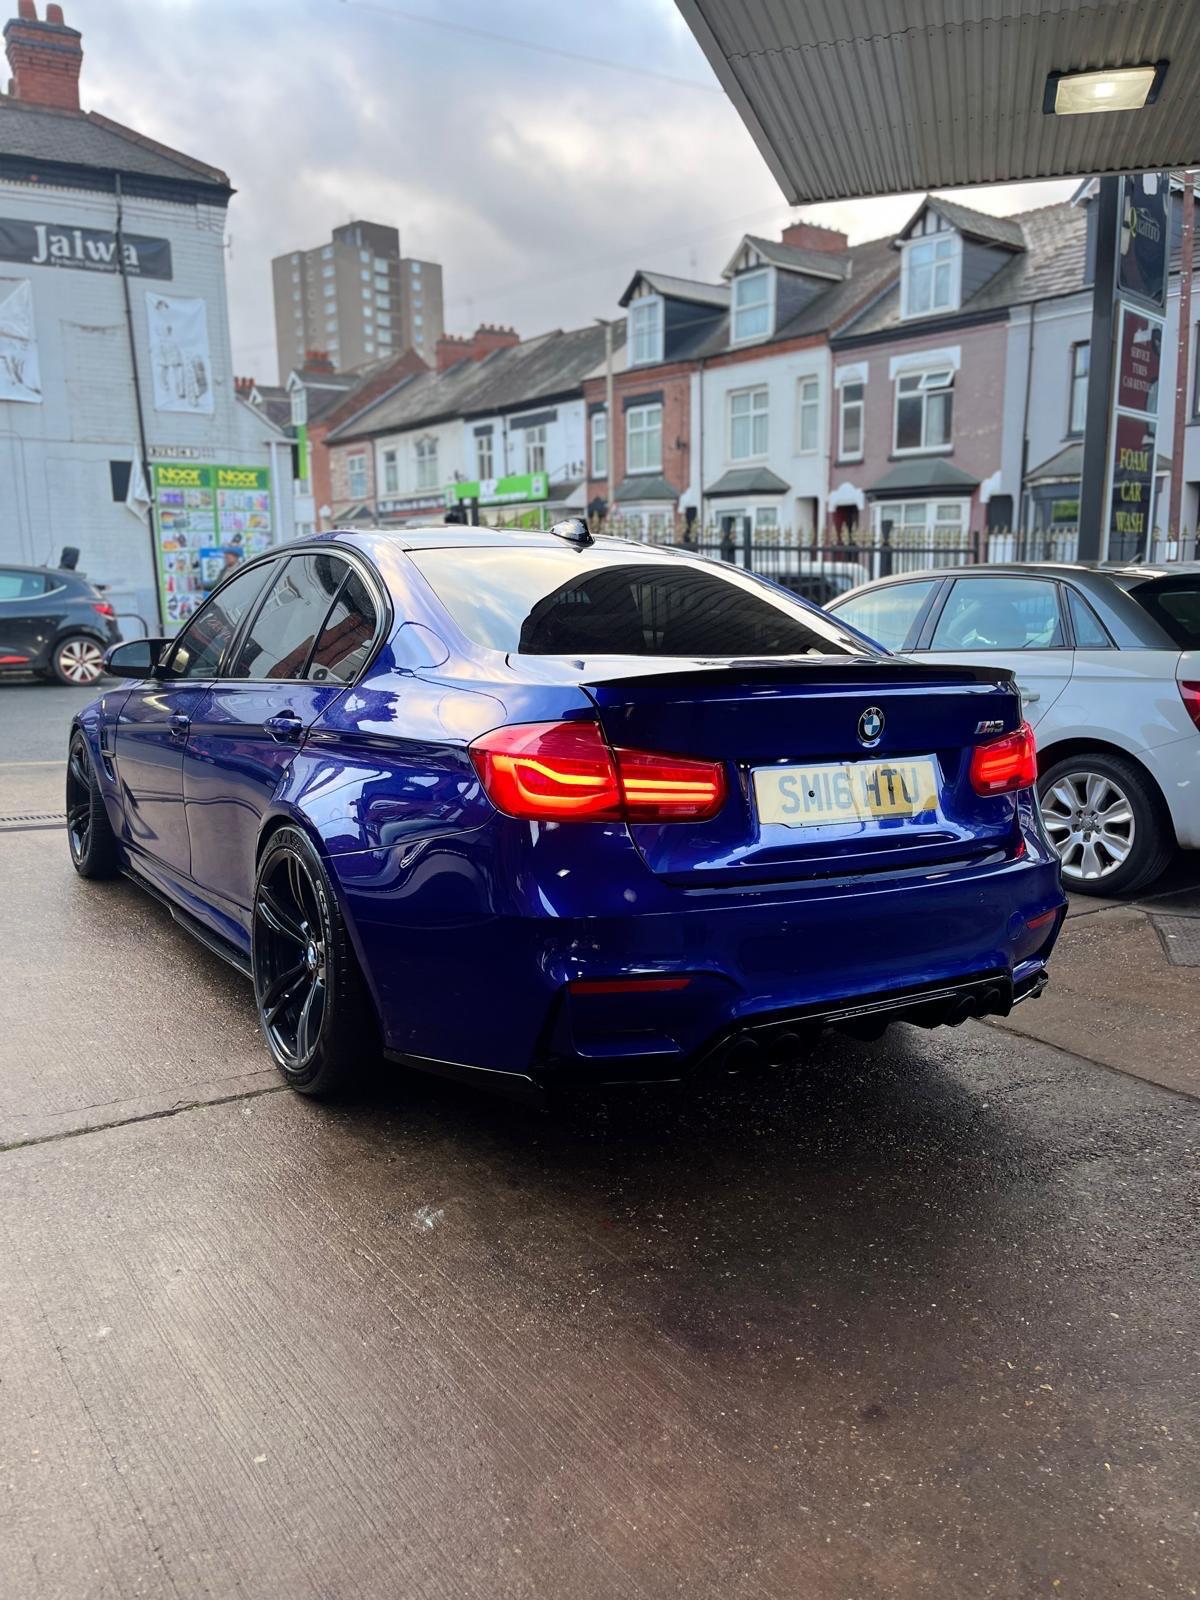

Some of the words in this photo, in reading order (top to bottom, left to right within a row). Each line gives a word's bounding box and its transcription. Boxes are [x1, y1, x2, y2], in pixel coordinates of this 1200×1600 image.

[32, 225, 139, 266] Jalwa
[1120, 448, 1147, 472] FOAM
[1121, 479, 1142, 503] CAR
[1116, 511, 1145, 533] WASH
[777, 772, 853, 814] SM16
[860, 767, 920, 808] HTU
